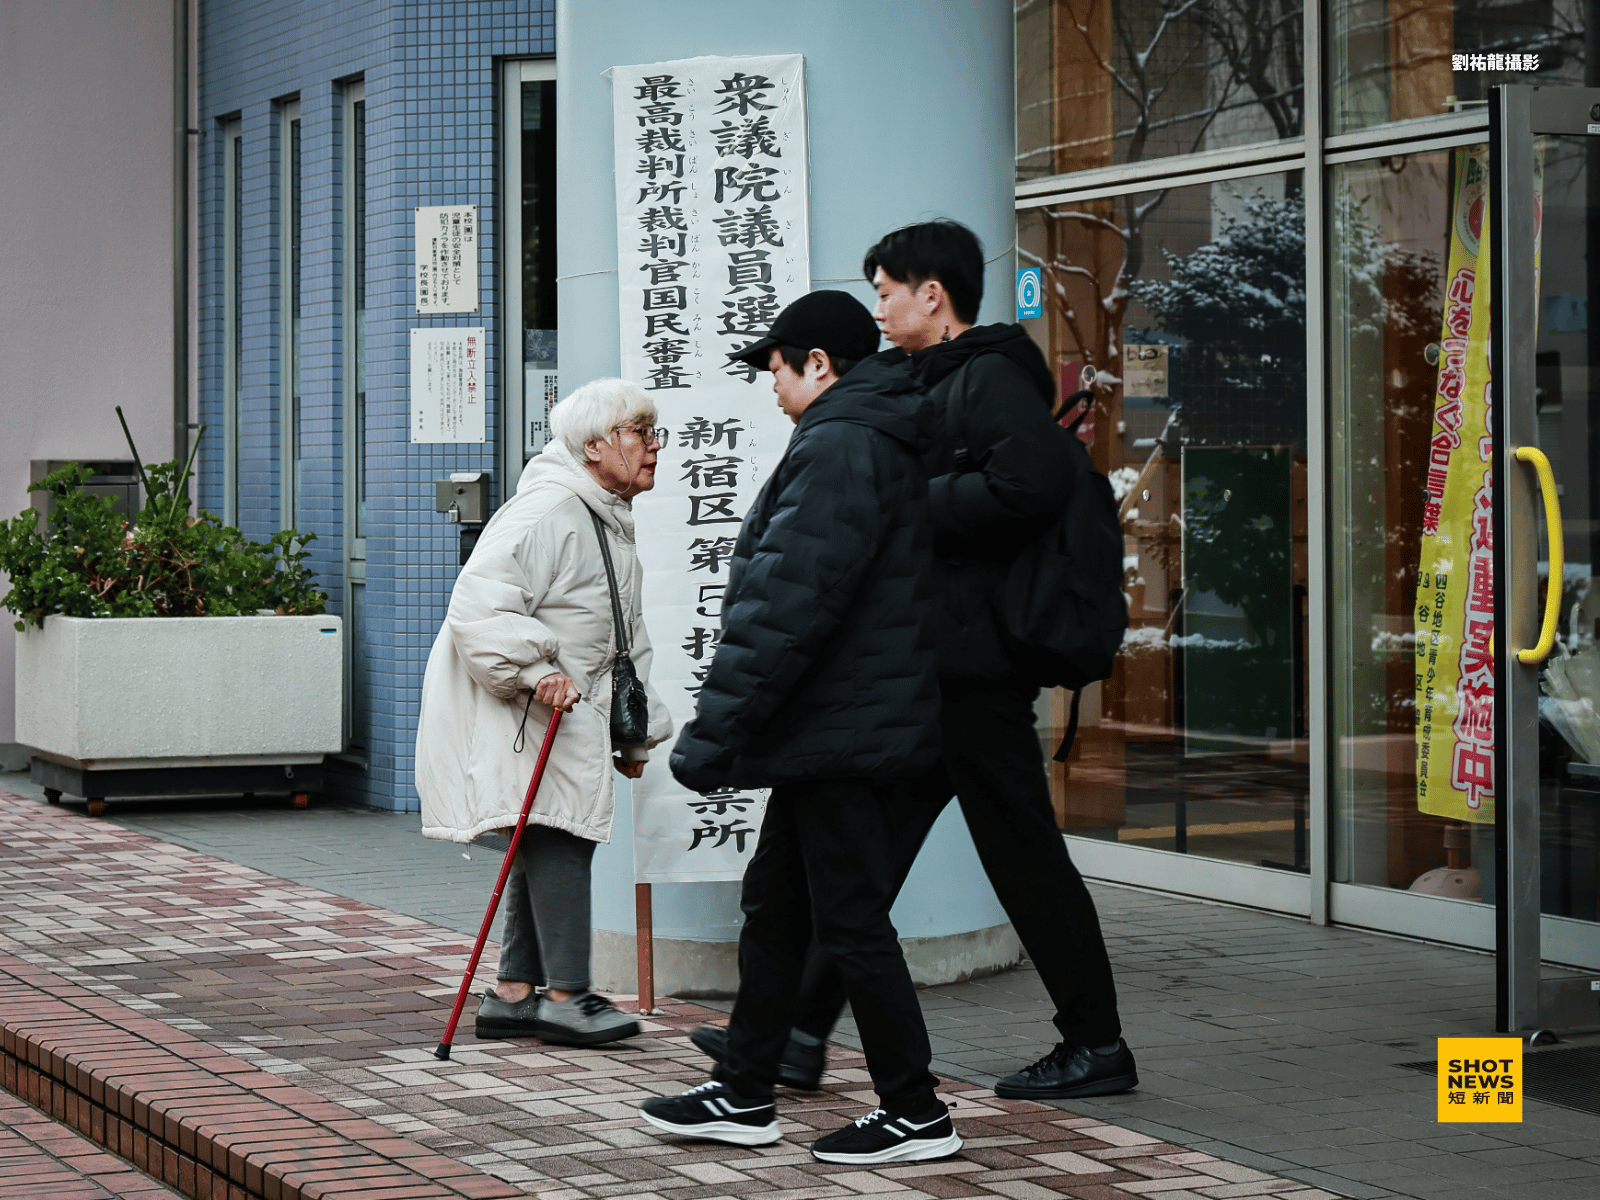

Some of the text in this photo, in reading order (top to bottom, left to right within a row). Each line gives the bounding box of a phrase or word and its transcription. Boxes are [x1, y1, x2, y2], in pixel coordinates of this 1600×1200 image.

[633, 74, 694, 391] 最高裁判所裁判官国民審査
[466, 336, 477, 405] 無断立入禁止
